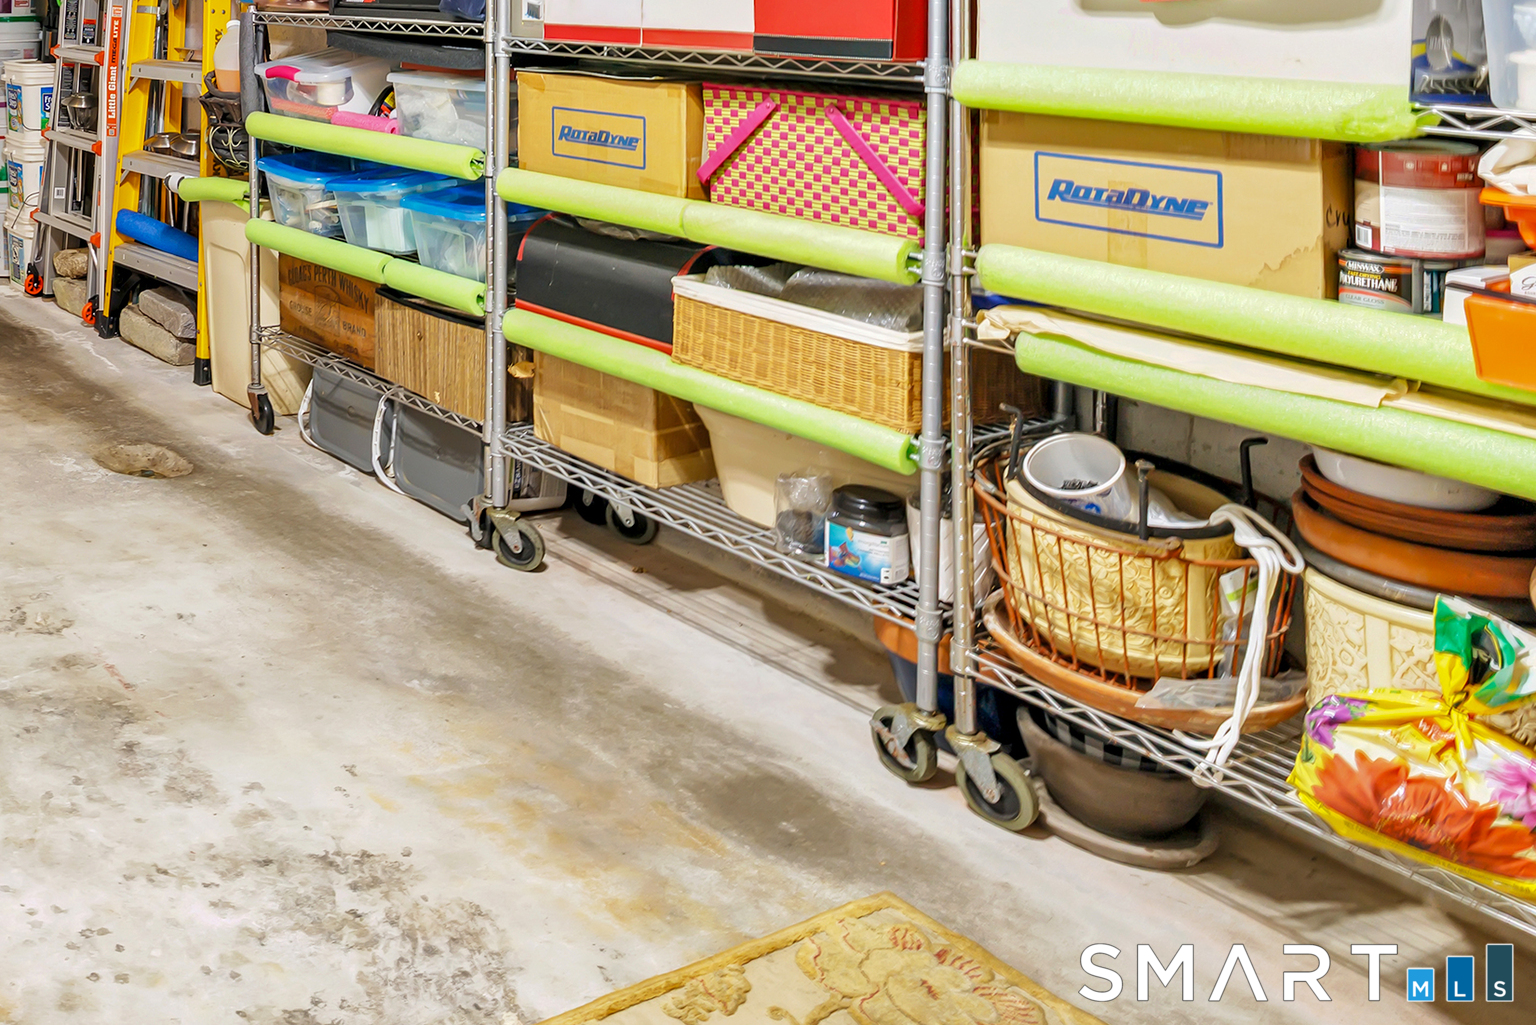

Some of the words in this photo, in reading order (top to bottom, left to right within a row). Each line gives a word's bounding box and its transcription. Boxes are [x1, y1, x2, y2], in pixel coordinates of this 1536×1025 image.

[108, 66, 117, 92] Giant
[109, 94, 117, 119] Little
[339, 274, 369, 314] WHISKY
[343, 320, 366, 339] BRAND
